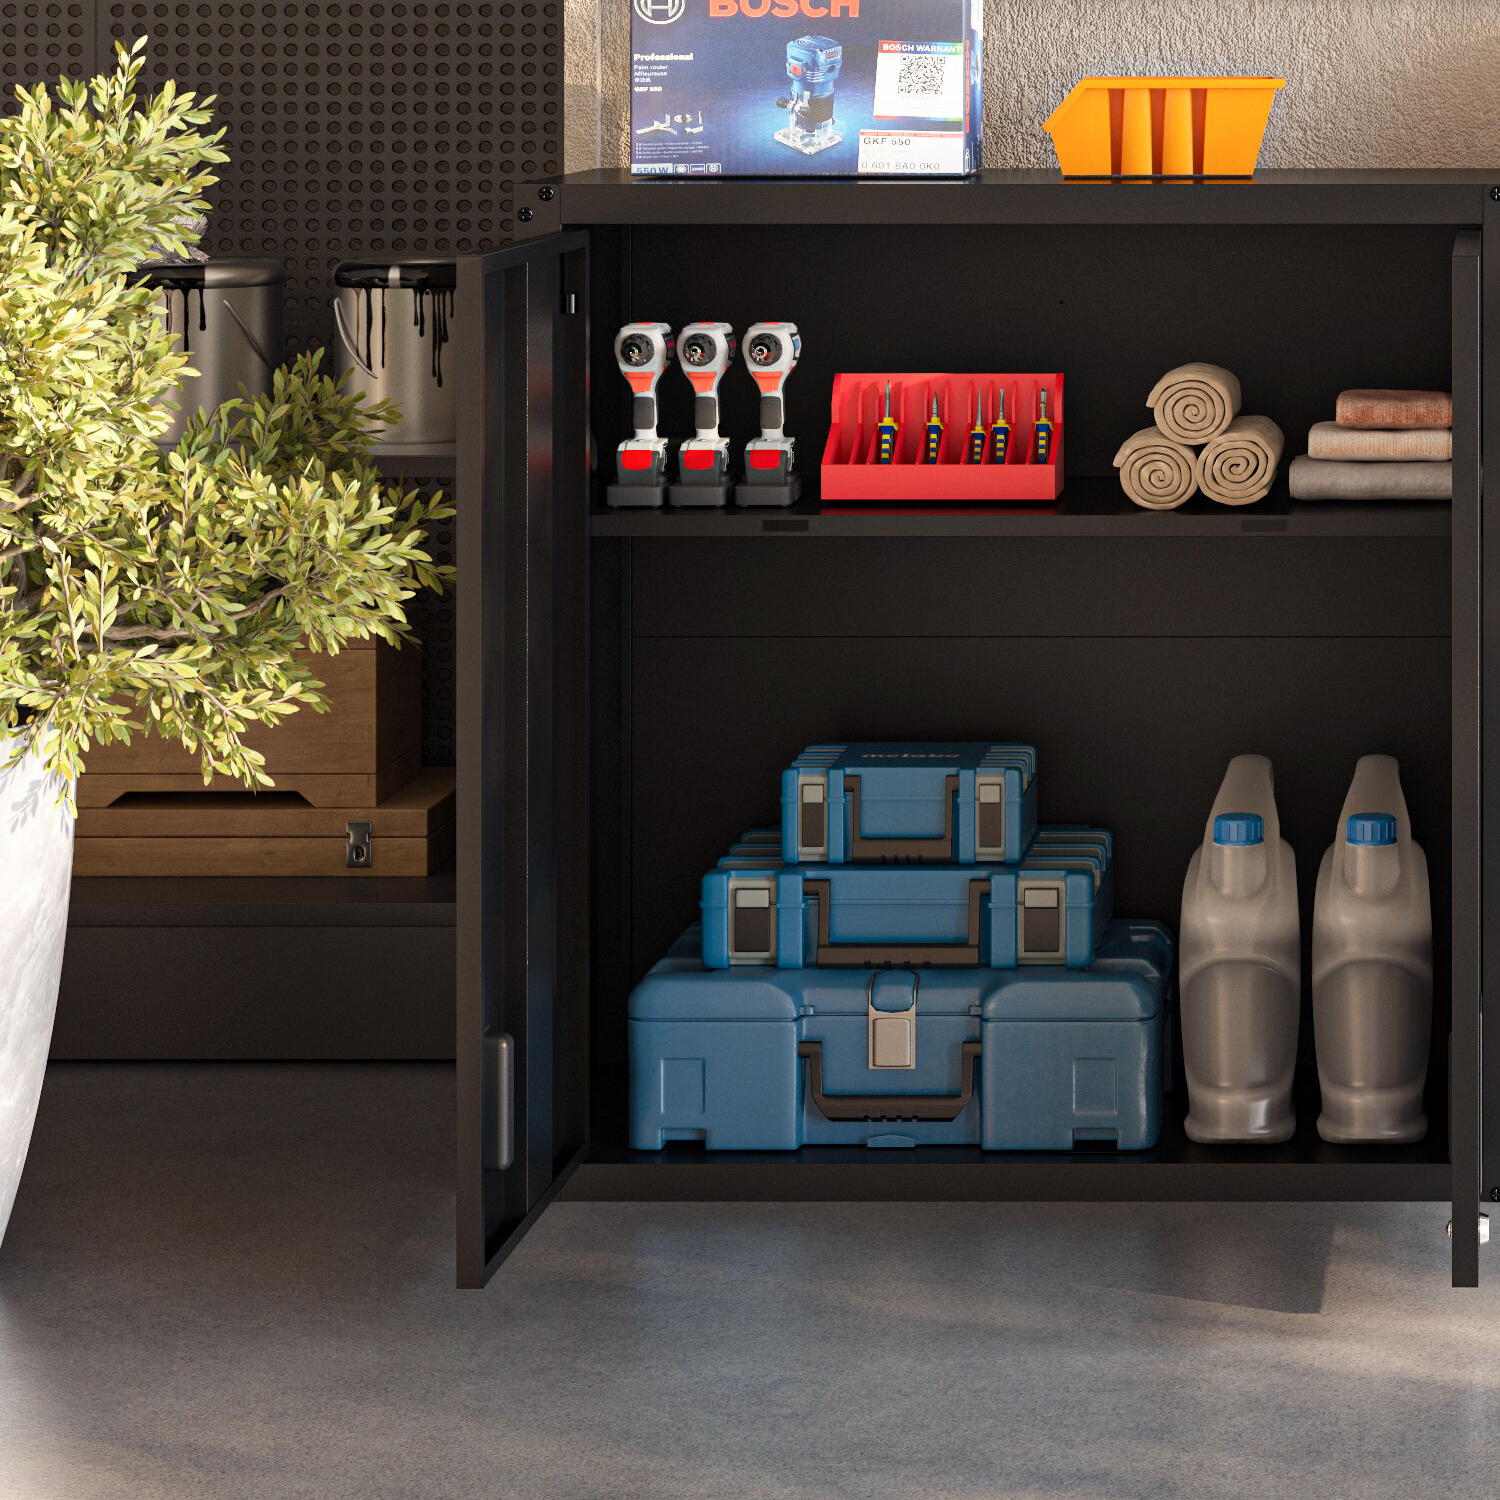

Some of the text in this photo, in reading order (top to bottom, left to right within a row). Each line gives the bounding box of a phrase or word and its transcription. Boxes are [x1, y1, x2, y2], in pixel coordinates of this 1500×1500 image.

[883, 43, 914, 52] BOSCH
[633, 52, 694, 61] Professional
[863, 137, 911, 146] GKF 550
